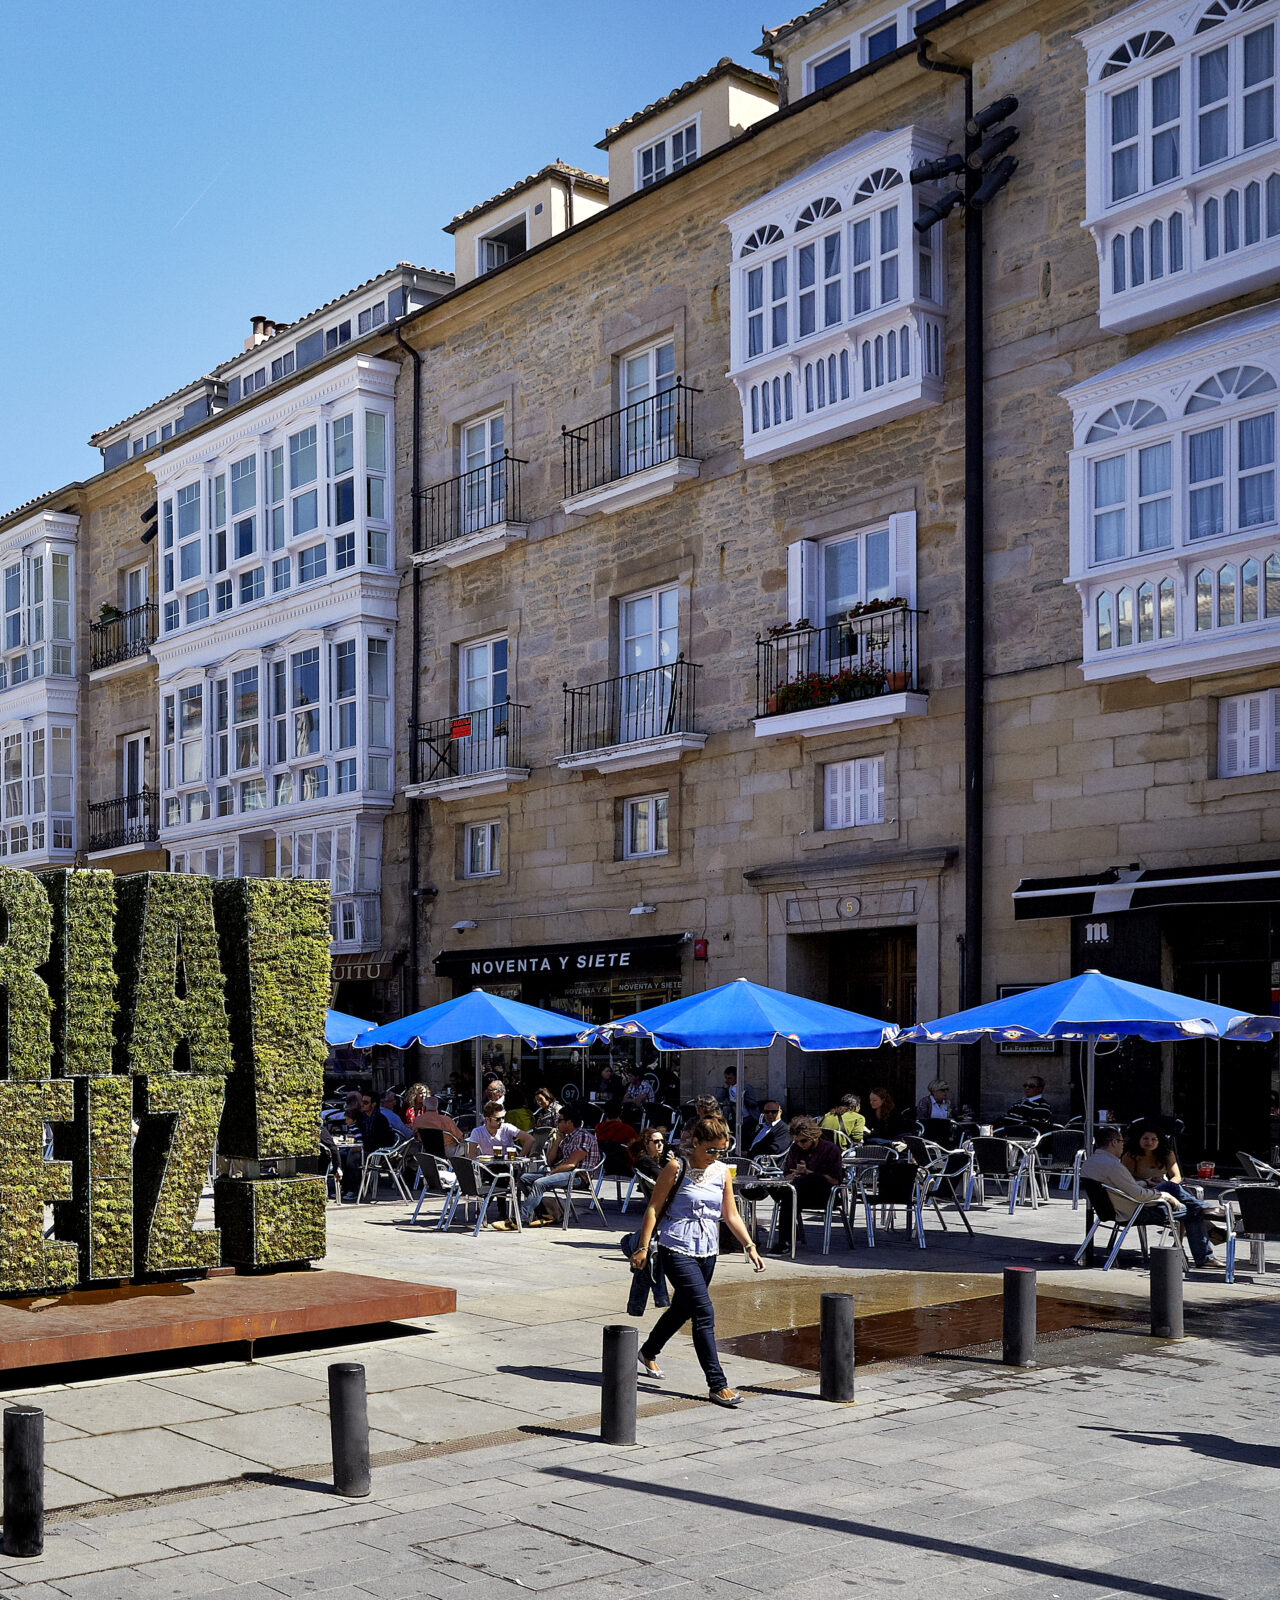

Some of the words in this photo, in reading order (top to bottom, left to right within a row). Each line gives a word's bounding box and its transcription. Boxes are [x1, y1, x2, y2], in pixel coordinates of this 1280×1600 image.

[846, 901, 853, 912] 5
[471, 957, 551, 975] NOVENTA
[559, 956, 569, 970] Y
[576, 952, 631, 969] SIETE
[618, 983, 653, 991] NOVENTA
[660, 981, 682, 989] SIETE
[565, 1089, 576, 1099] 97
